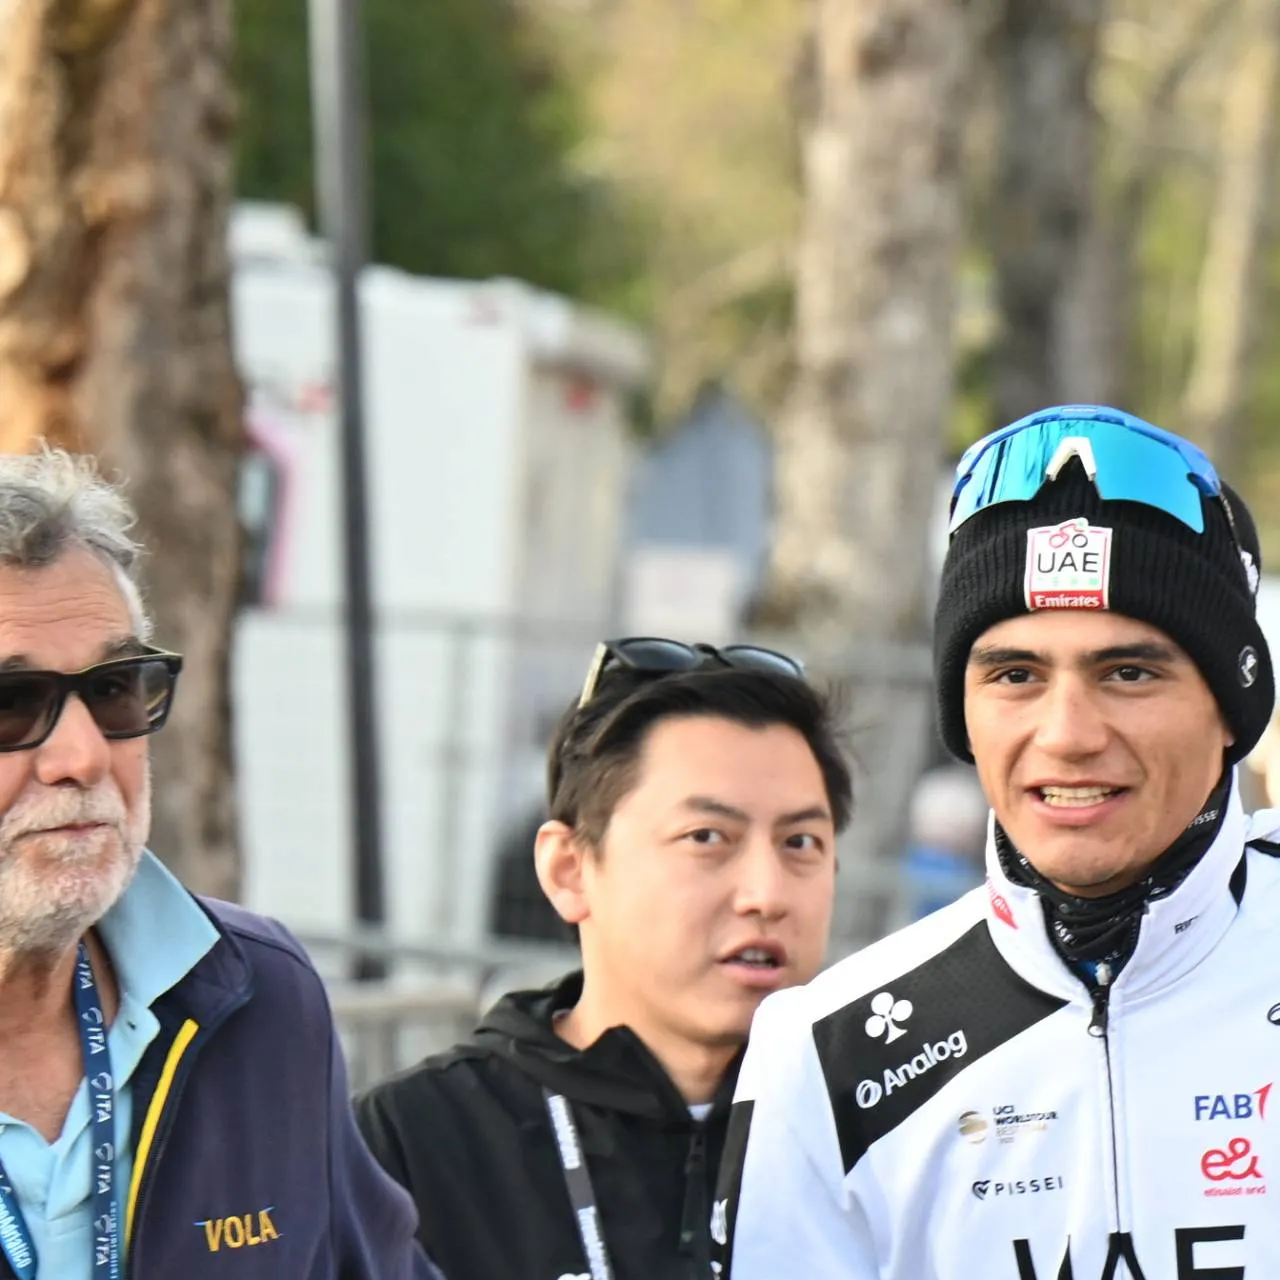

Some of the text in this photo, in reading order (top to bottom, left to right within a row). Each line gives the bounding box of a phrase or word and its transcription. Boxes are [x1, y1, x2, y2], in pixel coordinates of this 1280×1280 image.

[1037, 552, 1099, 573] UAE
[1034, 594, 1100, 608] Emirates
[87, 1027, 106, 1054] ITA
[883, 1029, 968, 1096] Analog
[95, 1094, 112, 1122] ITA
[97, 1165, 112, 1194] ITA
[994, 1176, 1064, 1196] PISSEI
[205, 1211, 279, 1252] VOLA
[95, 1237, 111, 1266] ITA
